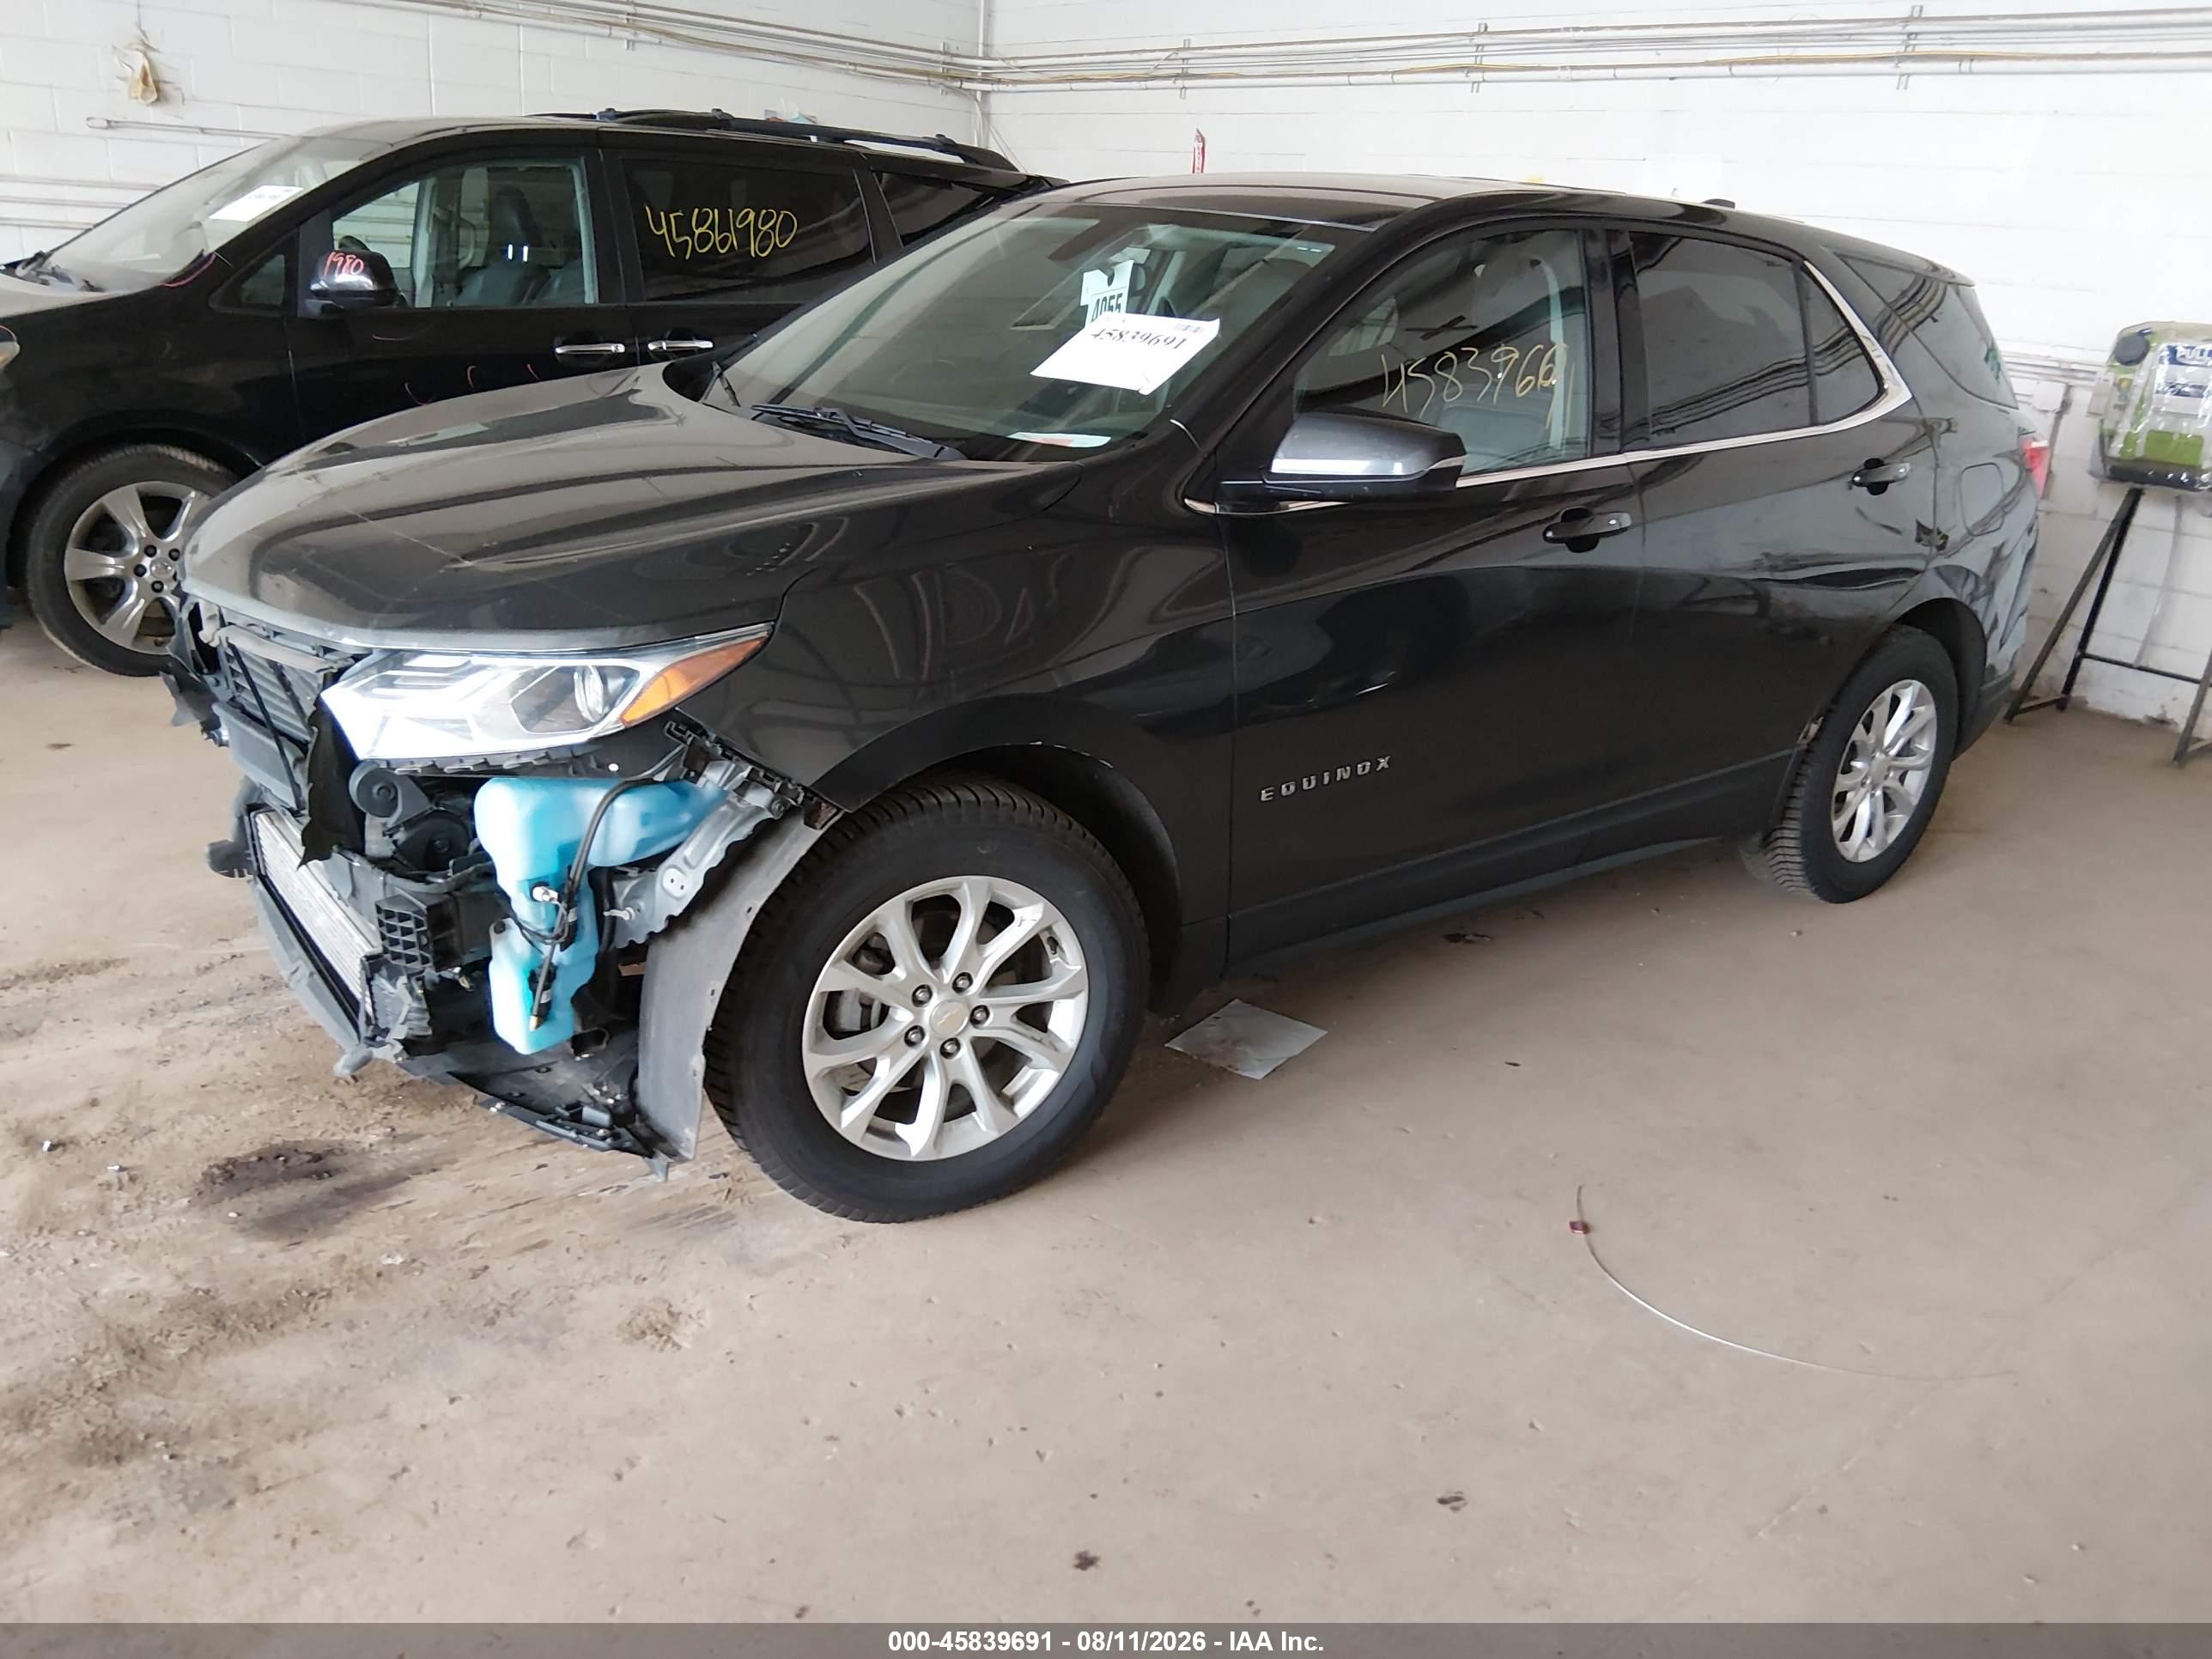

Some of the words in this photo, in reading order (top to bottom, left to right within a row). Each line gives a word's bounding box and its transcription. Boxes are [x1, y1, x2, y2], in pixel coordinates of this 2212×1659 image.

[645, 205, 799, 260] 45861980
[324, 251, 365, 277] 1980
[1091, 327, 1188, 350] 45839691
[1260, 756, 1391, 802] EQUINOX
